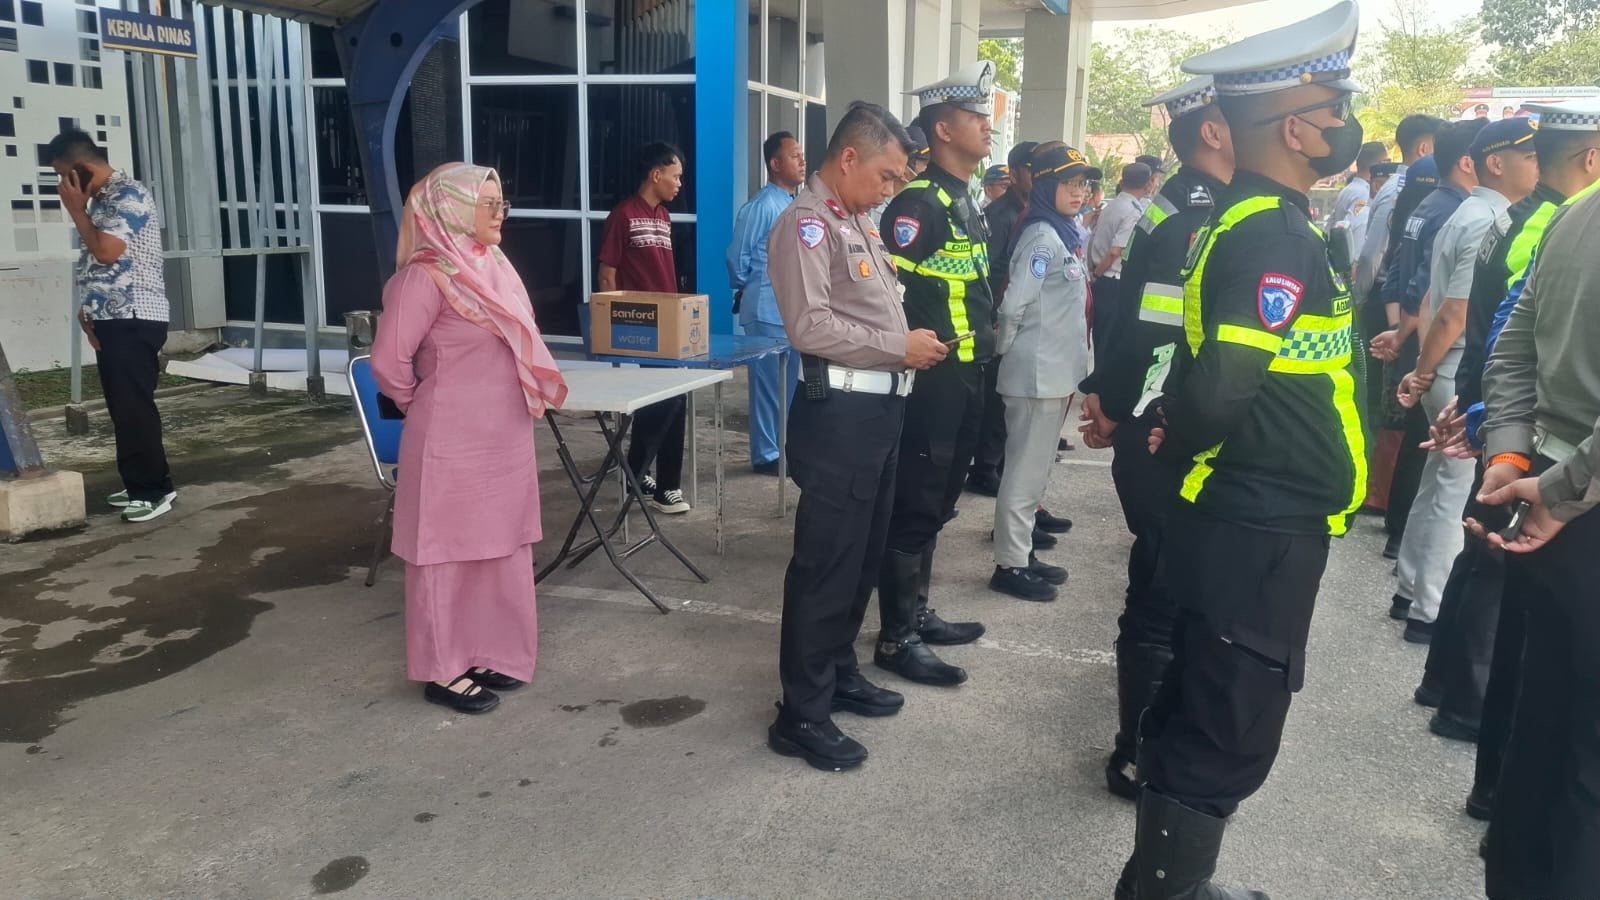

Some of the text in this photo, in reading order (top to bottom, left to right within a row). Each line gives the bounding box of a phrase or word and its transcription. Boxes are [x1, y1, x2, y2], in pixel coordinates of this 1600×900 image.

[107, 18, 191, 46] KEPALA DINAS
[1282, 279, 1301, 294] LINTAS
[612, 309, 656, 321] sanford
[618, 334, 652, 346] water
